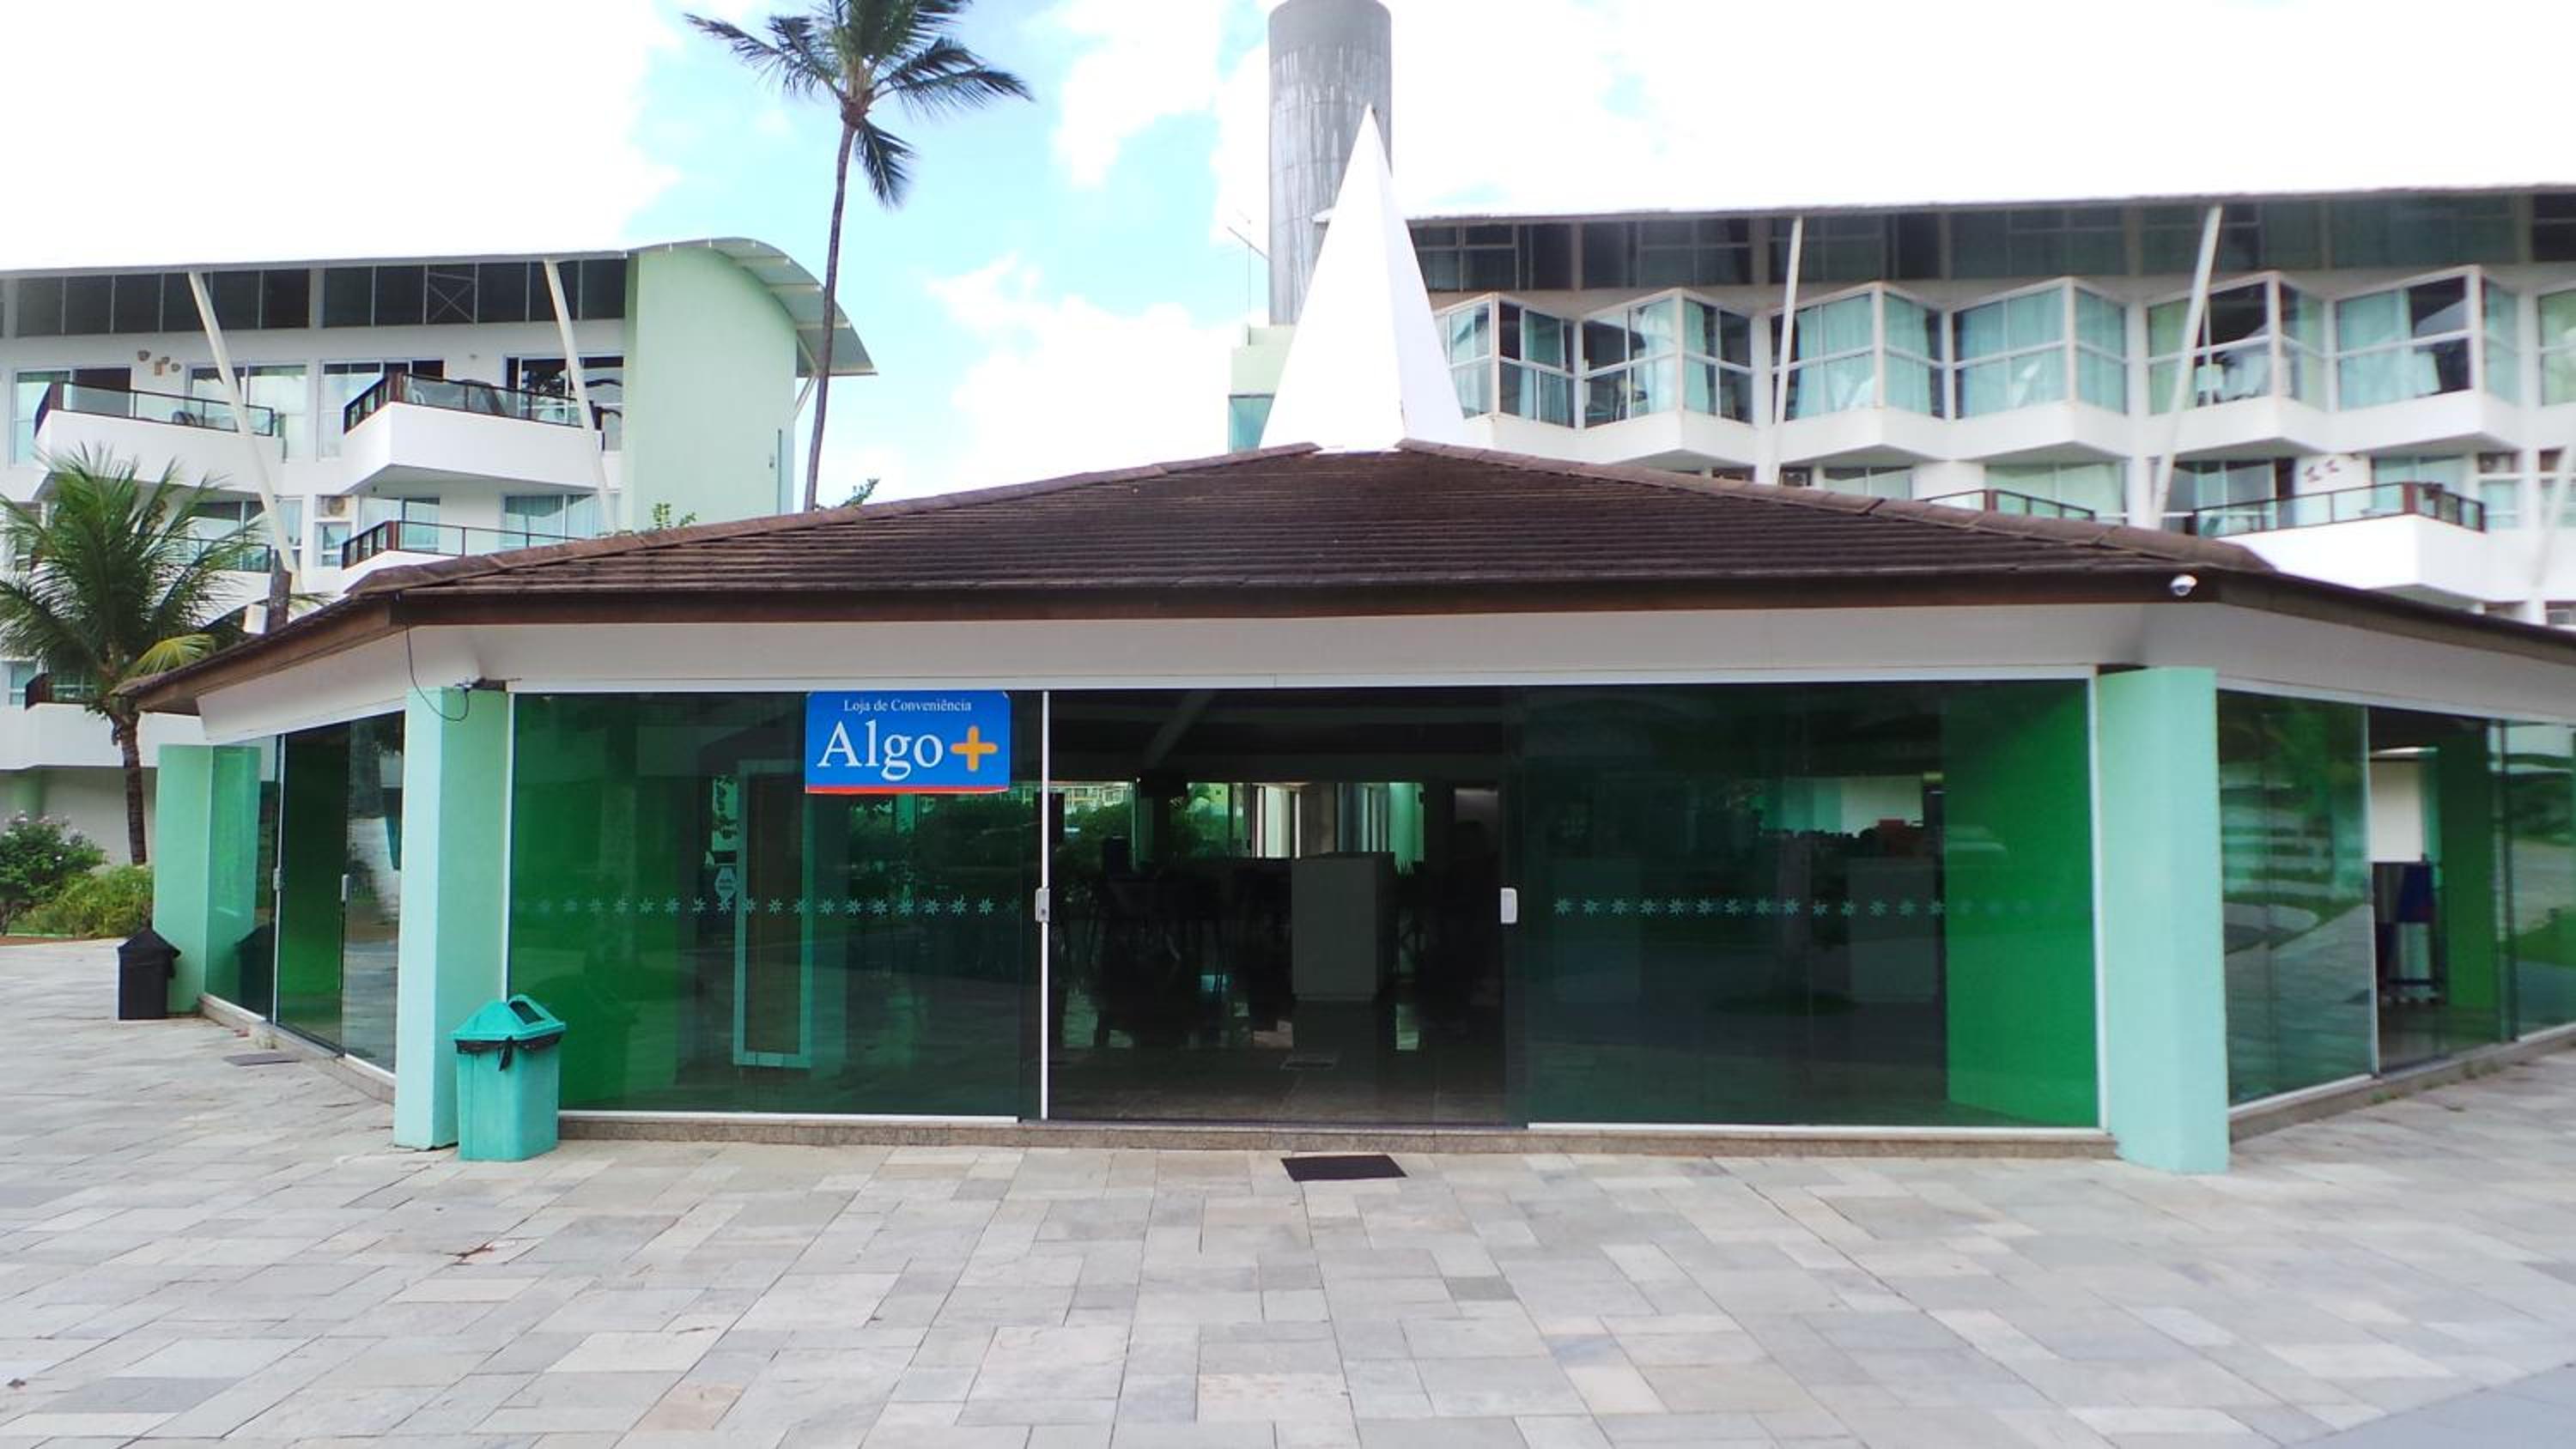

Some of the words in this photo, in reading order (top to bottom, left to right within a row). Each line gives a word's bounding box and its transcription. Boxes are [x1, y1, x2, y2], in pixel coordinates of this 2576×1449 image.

[843, 699, 871, 715] Loja
[872, 699, 889, 713] de
[890, 698, 972, 713] Conveniência
